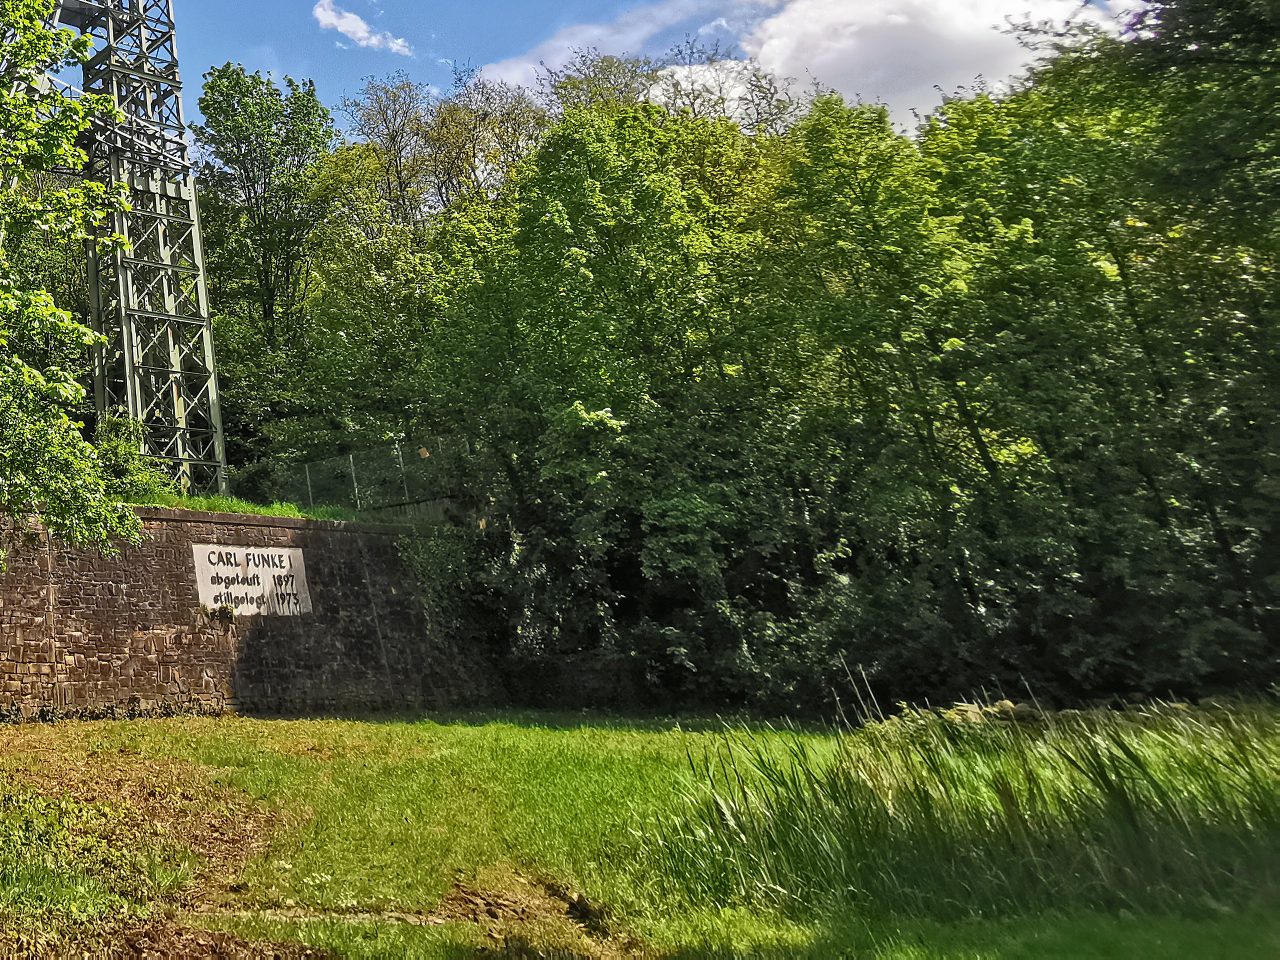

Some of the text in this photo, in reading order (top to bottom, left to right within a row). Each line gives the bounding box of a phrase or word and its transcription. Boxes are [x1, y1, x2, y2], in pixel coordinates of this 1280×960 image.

[207, 550, 241, 568] CARL
[245, 552, 286, 569] FUNKE
[272, 574, 295, 589] 1897
[275, 592, 299, 607] 1973
